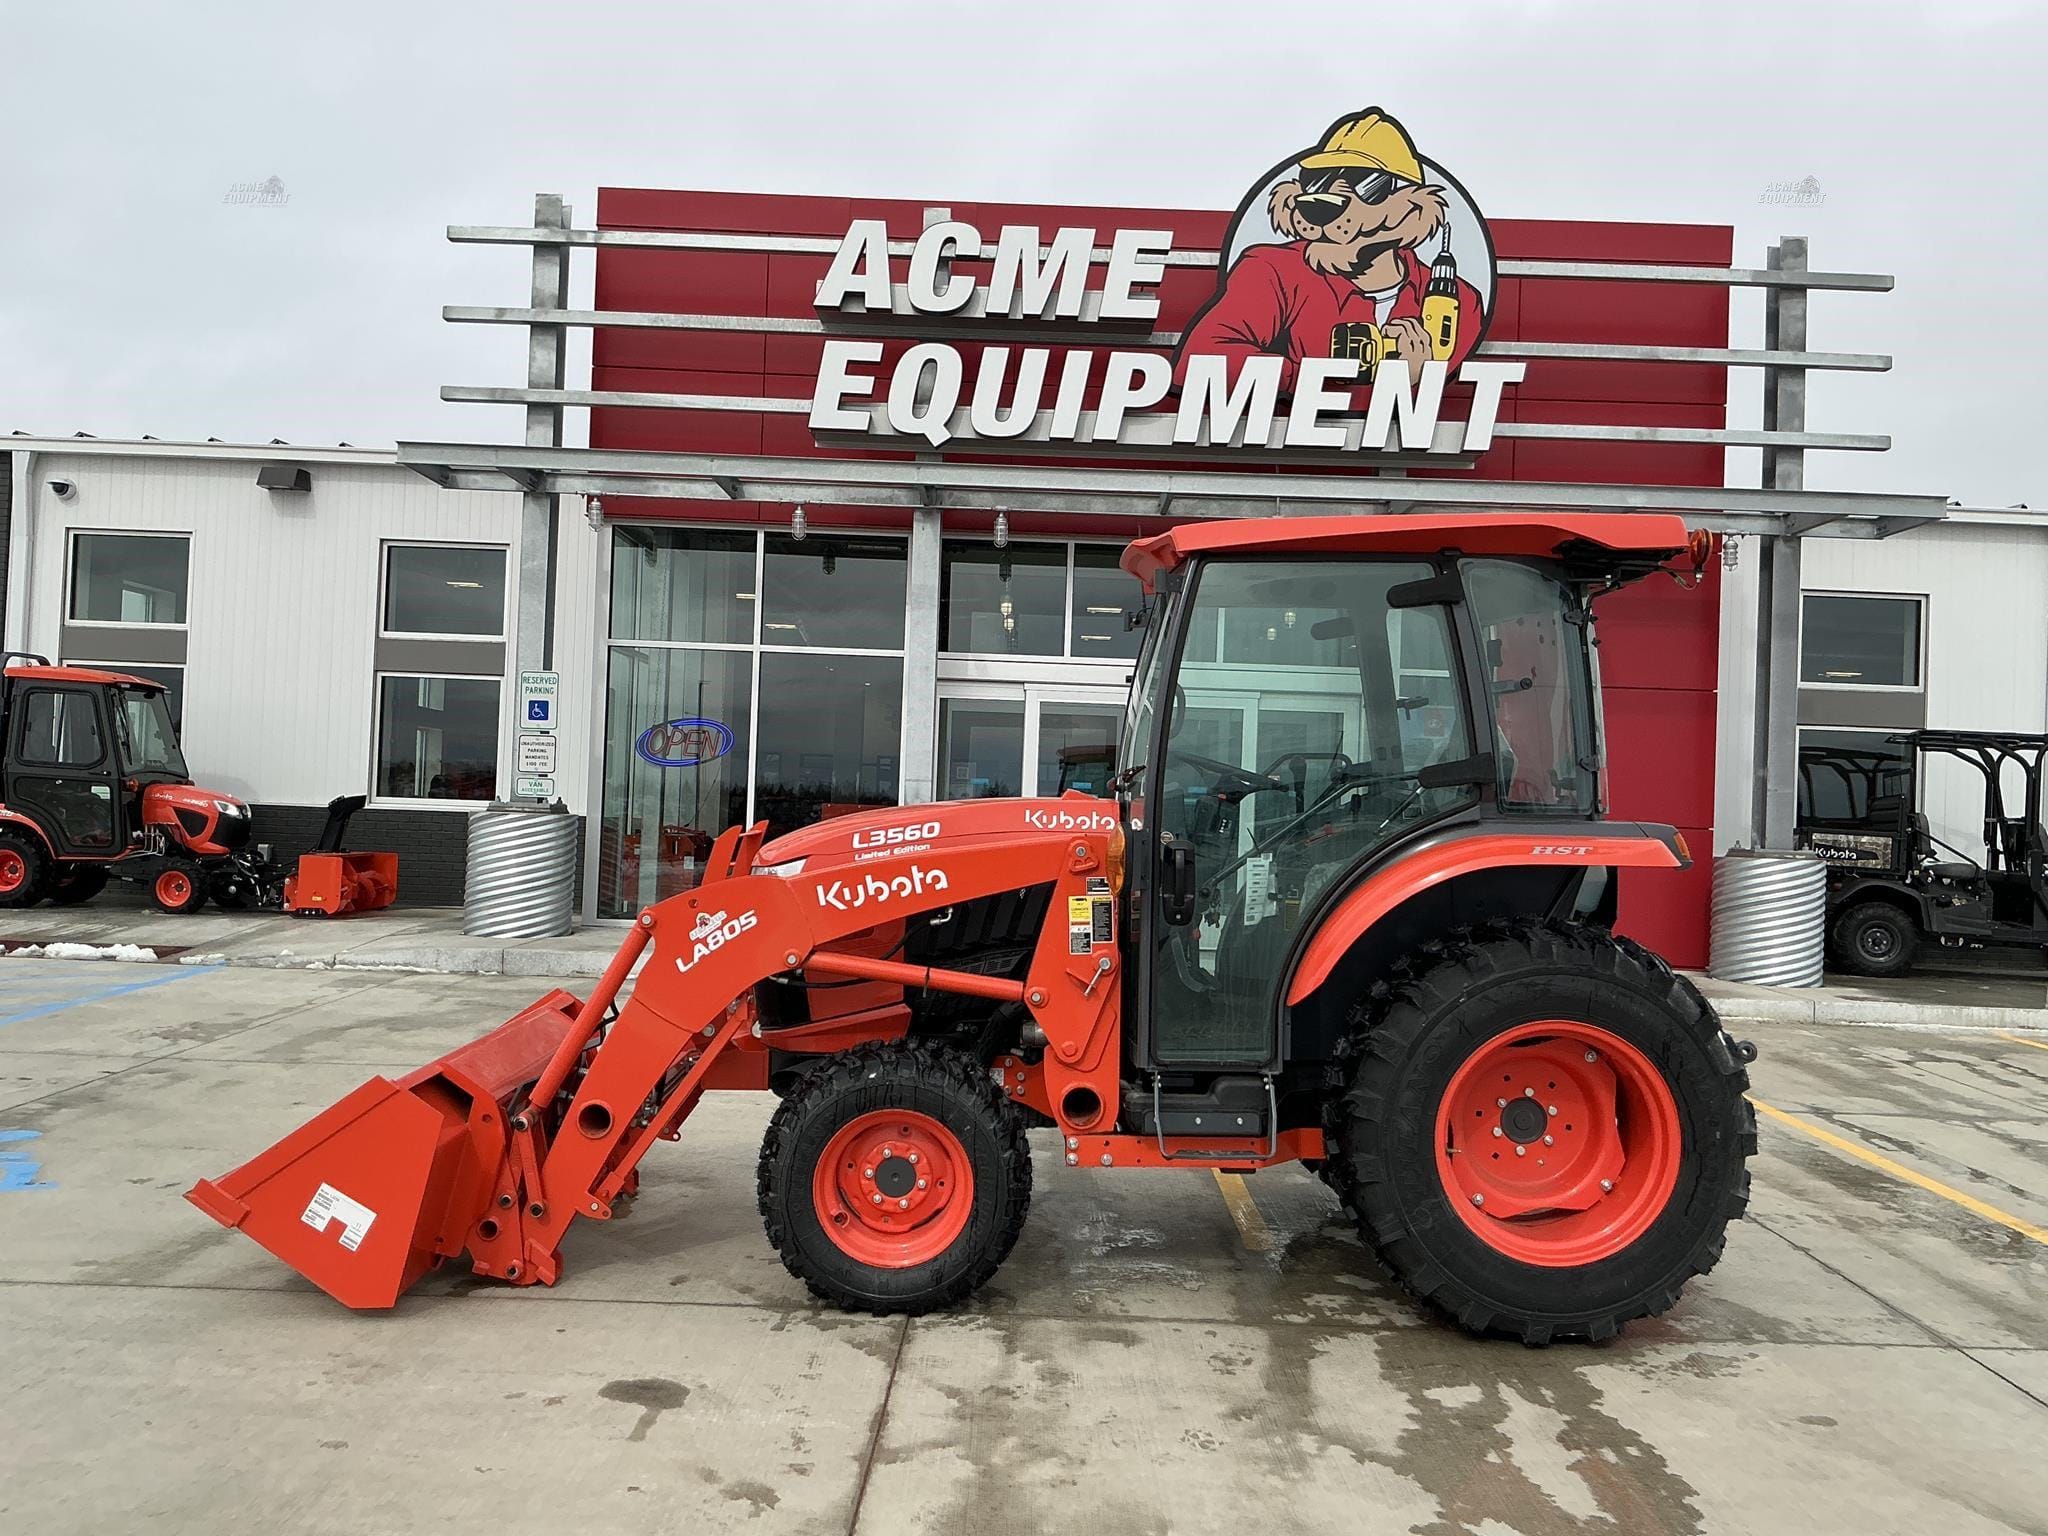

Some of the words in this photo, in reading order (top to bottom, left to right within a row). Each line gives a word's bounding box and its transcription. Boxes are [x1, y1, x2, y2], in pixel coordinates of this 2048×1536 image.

[814, 218, 1174, 320] ACME
[808, 340, 1526, 451] EQUIPMENT
[522, 676, 557, 685] RESERVED
[525, 686, 554, 695] PARKING
[648, 727, 720, 757] OPEN
[1025, 809, 1116, 830] Kubota
[852, 821, 941, 849] L3560
[855, 849, 890, 861] Limited
[893, 843, 931, 856] Edition
[1529, 846, 1594, 855] HST
[1815, 847, 1857, 860] Kubota
[816, 865, 949, 910] Kubota
[675, 909, 758, 973] LA805
